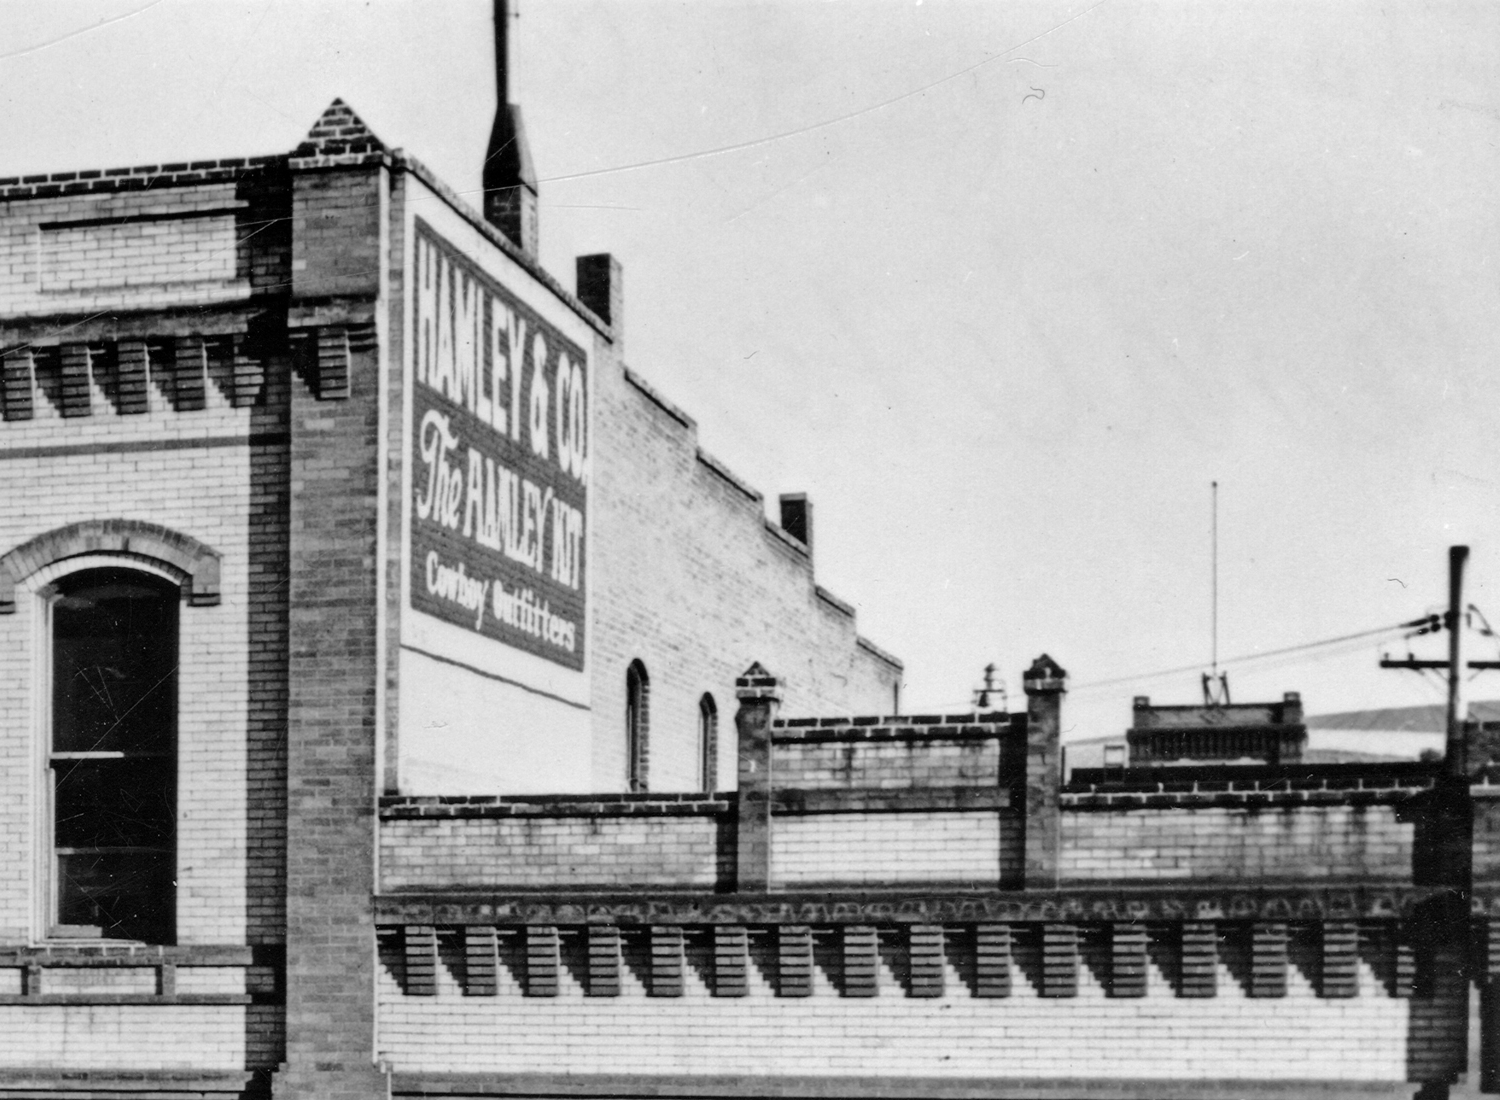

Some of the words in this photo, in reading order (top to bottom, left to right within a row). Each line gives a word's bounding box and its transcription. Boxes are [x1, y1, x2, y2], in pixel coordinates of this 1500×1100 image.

[417, 235, 527, 442] HAMLEY
[529, 331, 550, 460] &
[416, 409, 461, 531] The
[462, 447, 554, 575] HAMLEY
[551, 496, 584, 591] KIT
[425, 549, 490, 632] Cowboy
[492, 578, 577, 653] Outfitters
